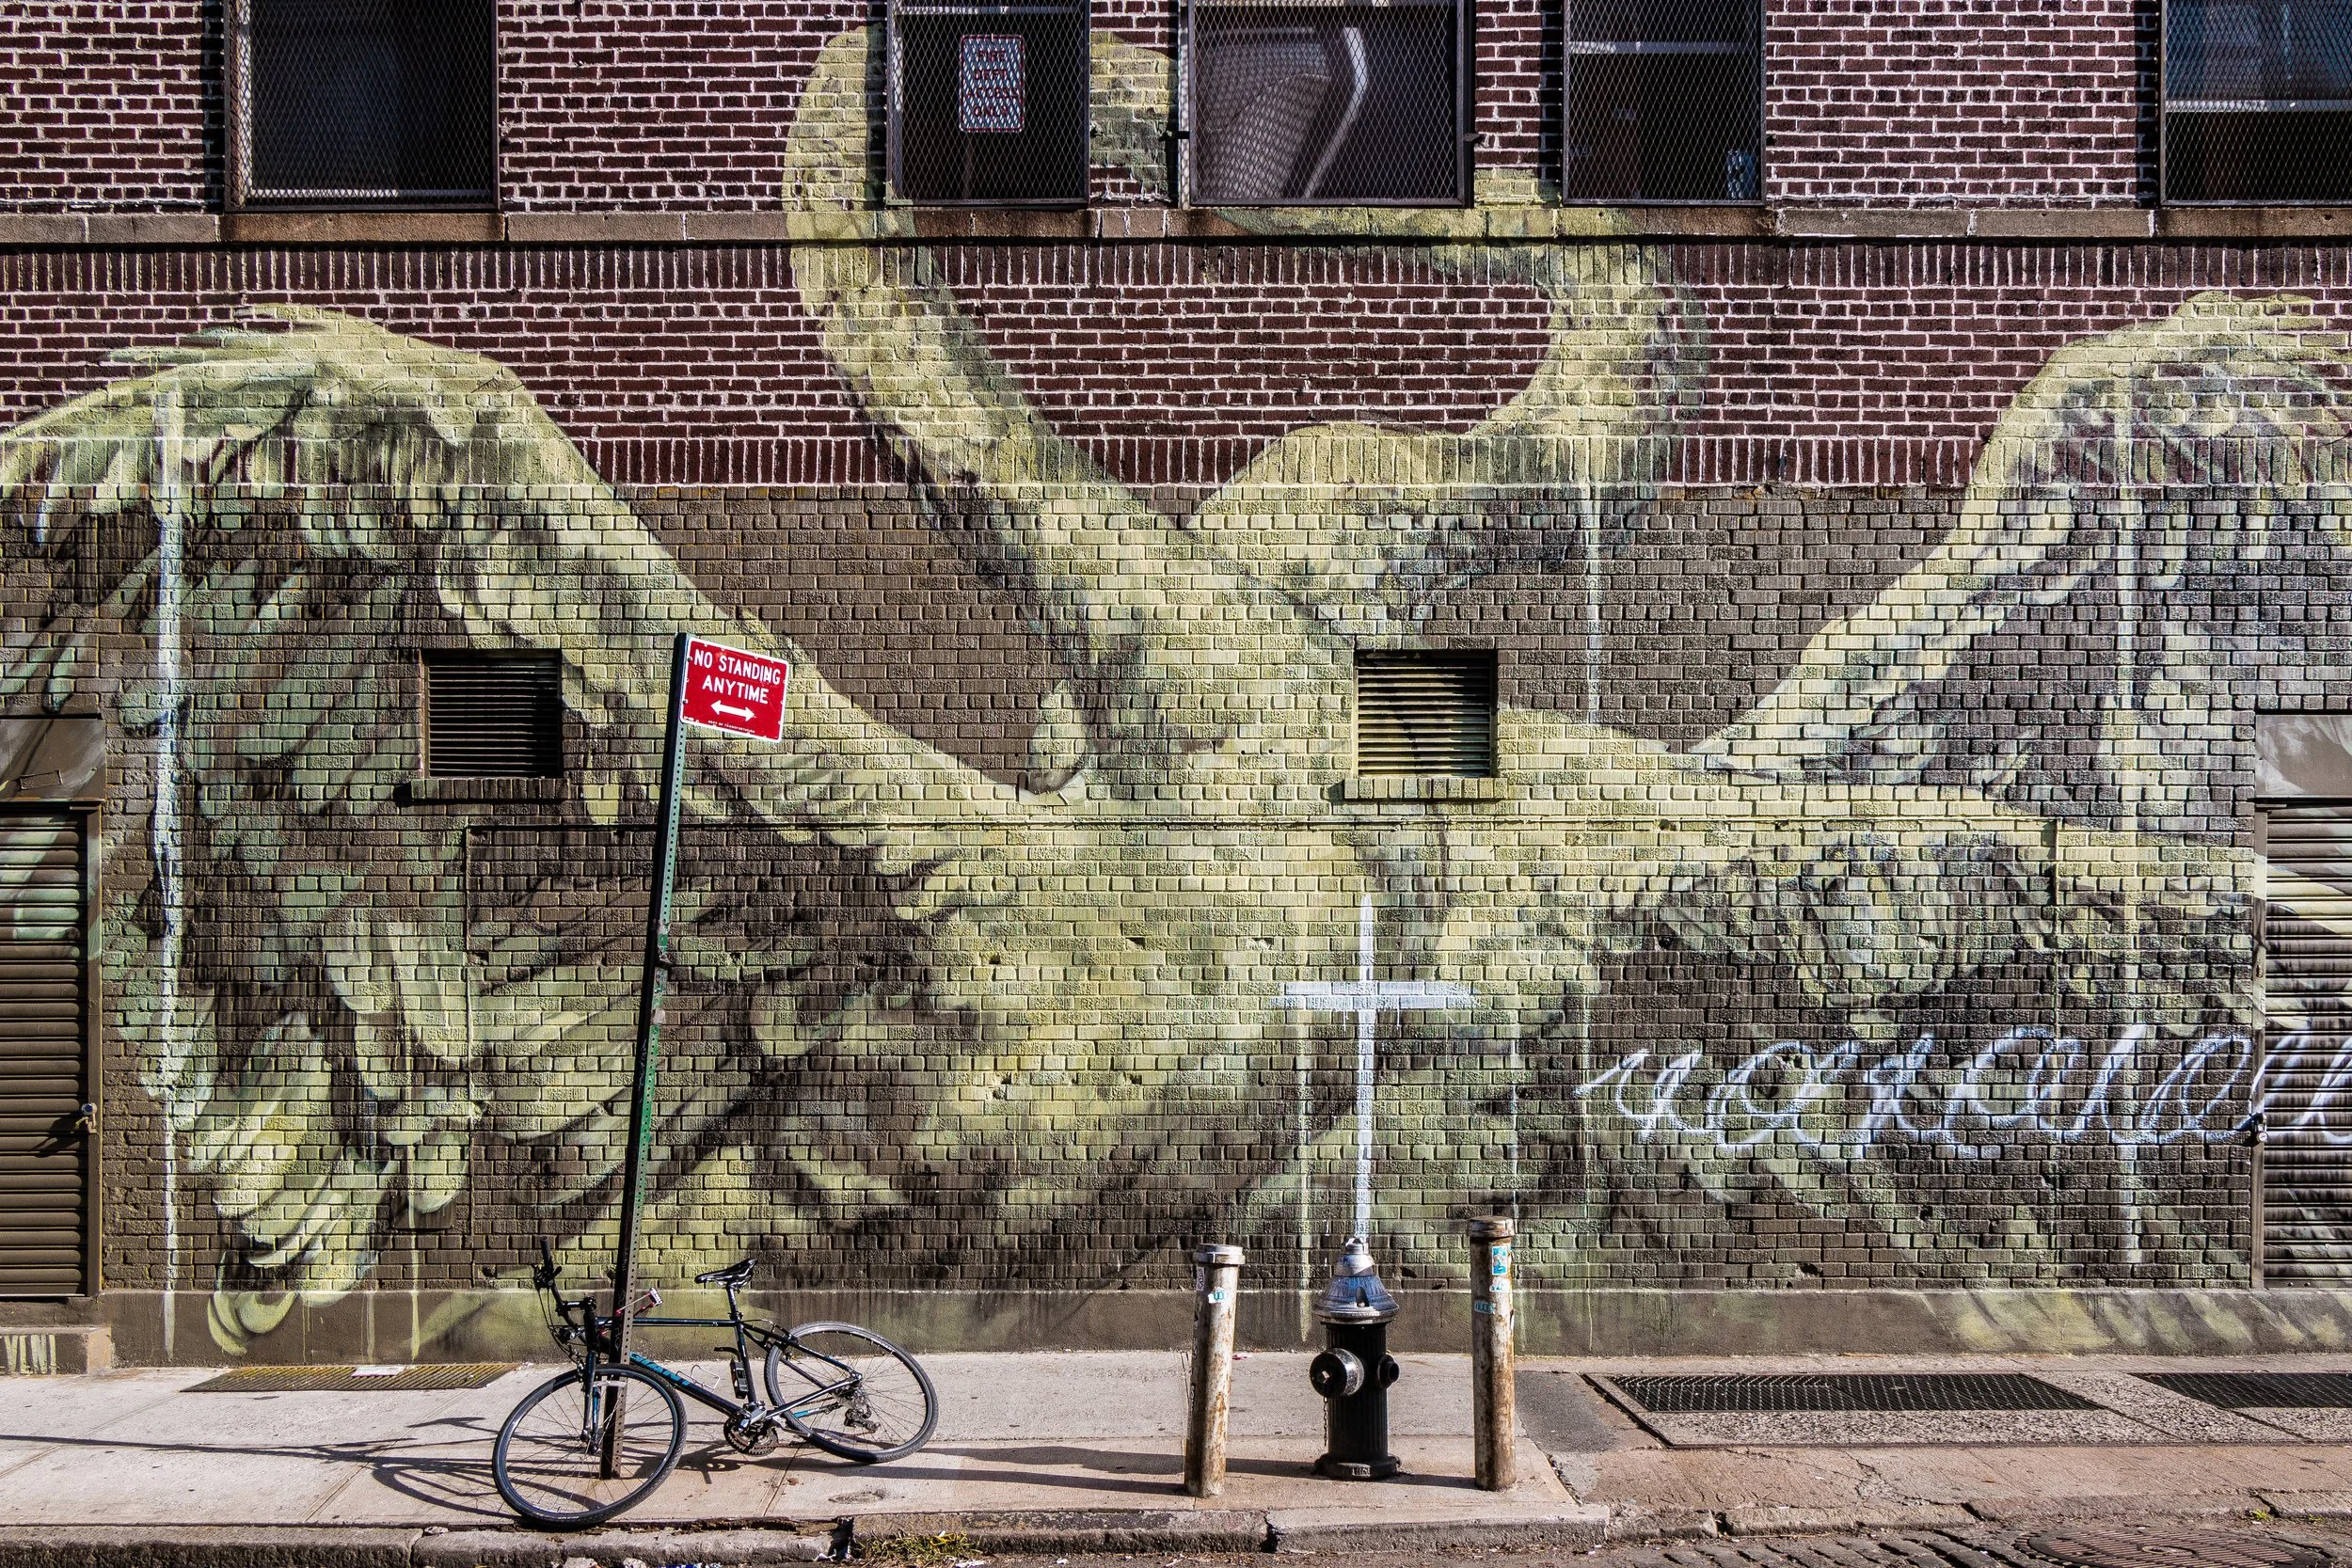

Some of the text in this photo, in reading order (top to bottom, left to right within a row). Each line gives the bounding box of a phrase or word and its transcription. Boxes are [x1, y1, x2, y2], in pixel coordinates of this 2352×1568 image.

[977, 50, 1006, 60] FIRE
[694, 649, 781, 685] NO STANDING
[702, 675, 769, 705] ANYTIME
[629, 1350, 691, 1386] GIANT
